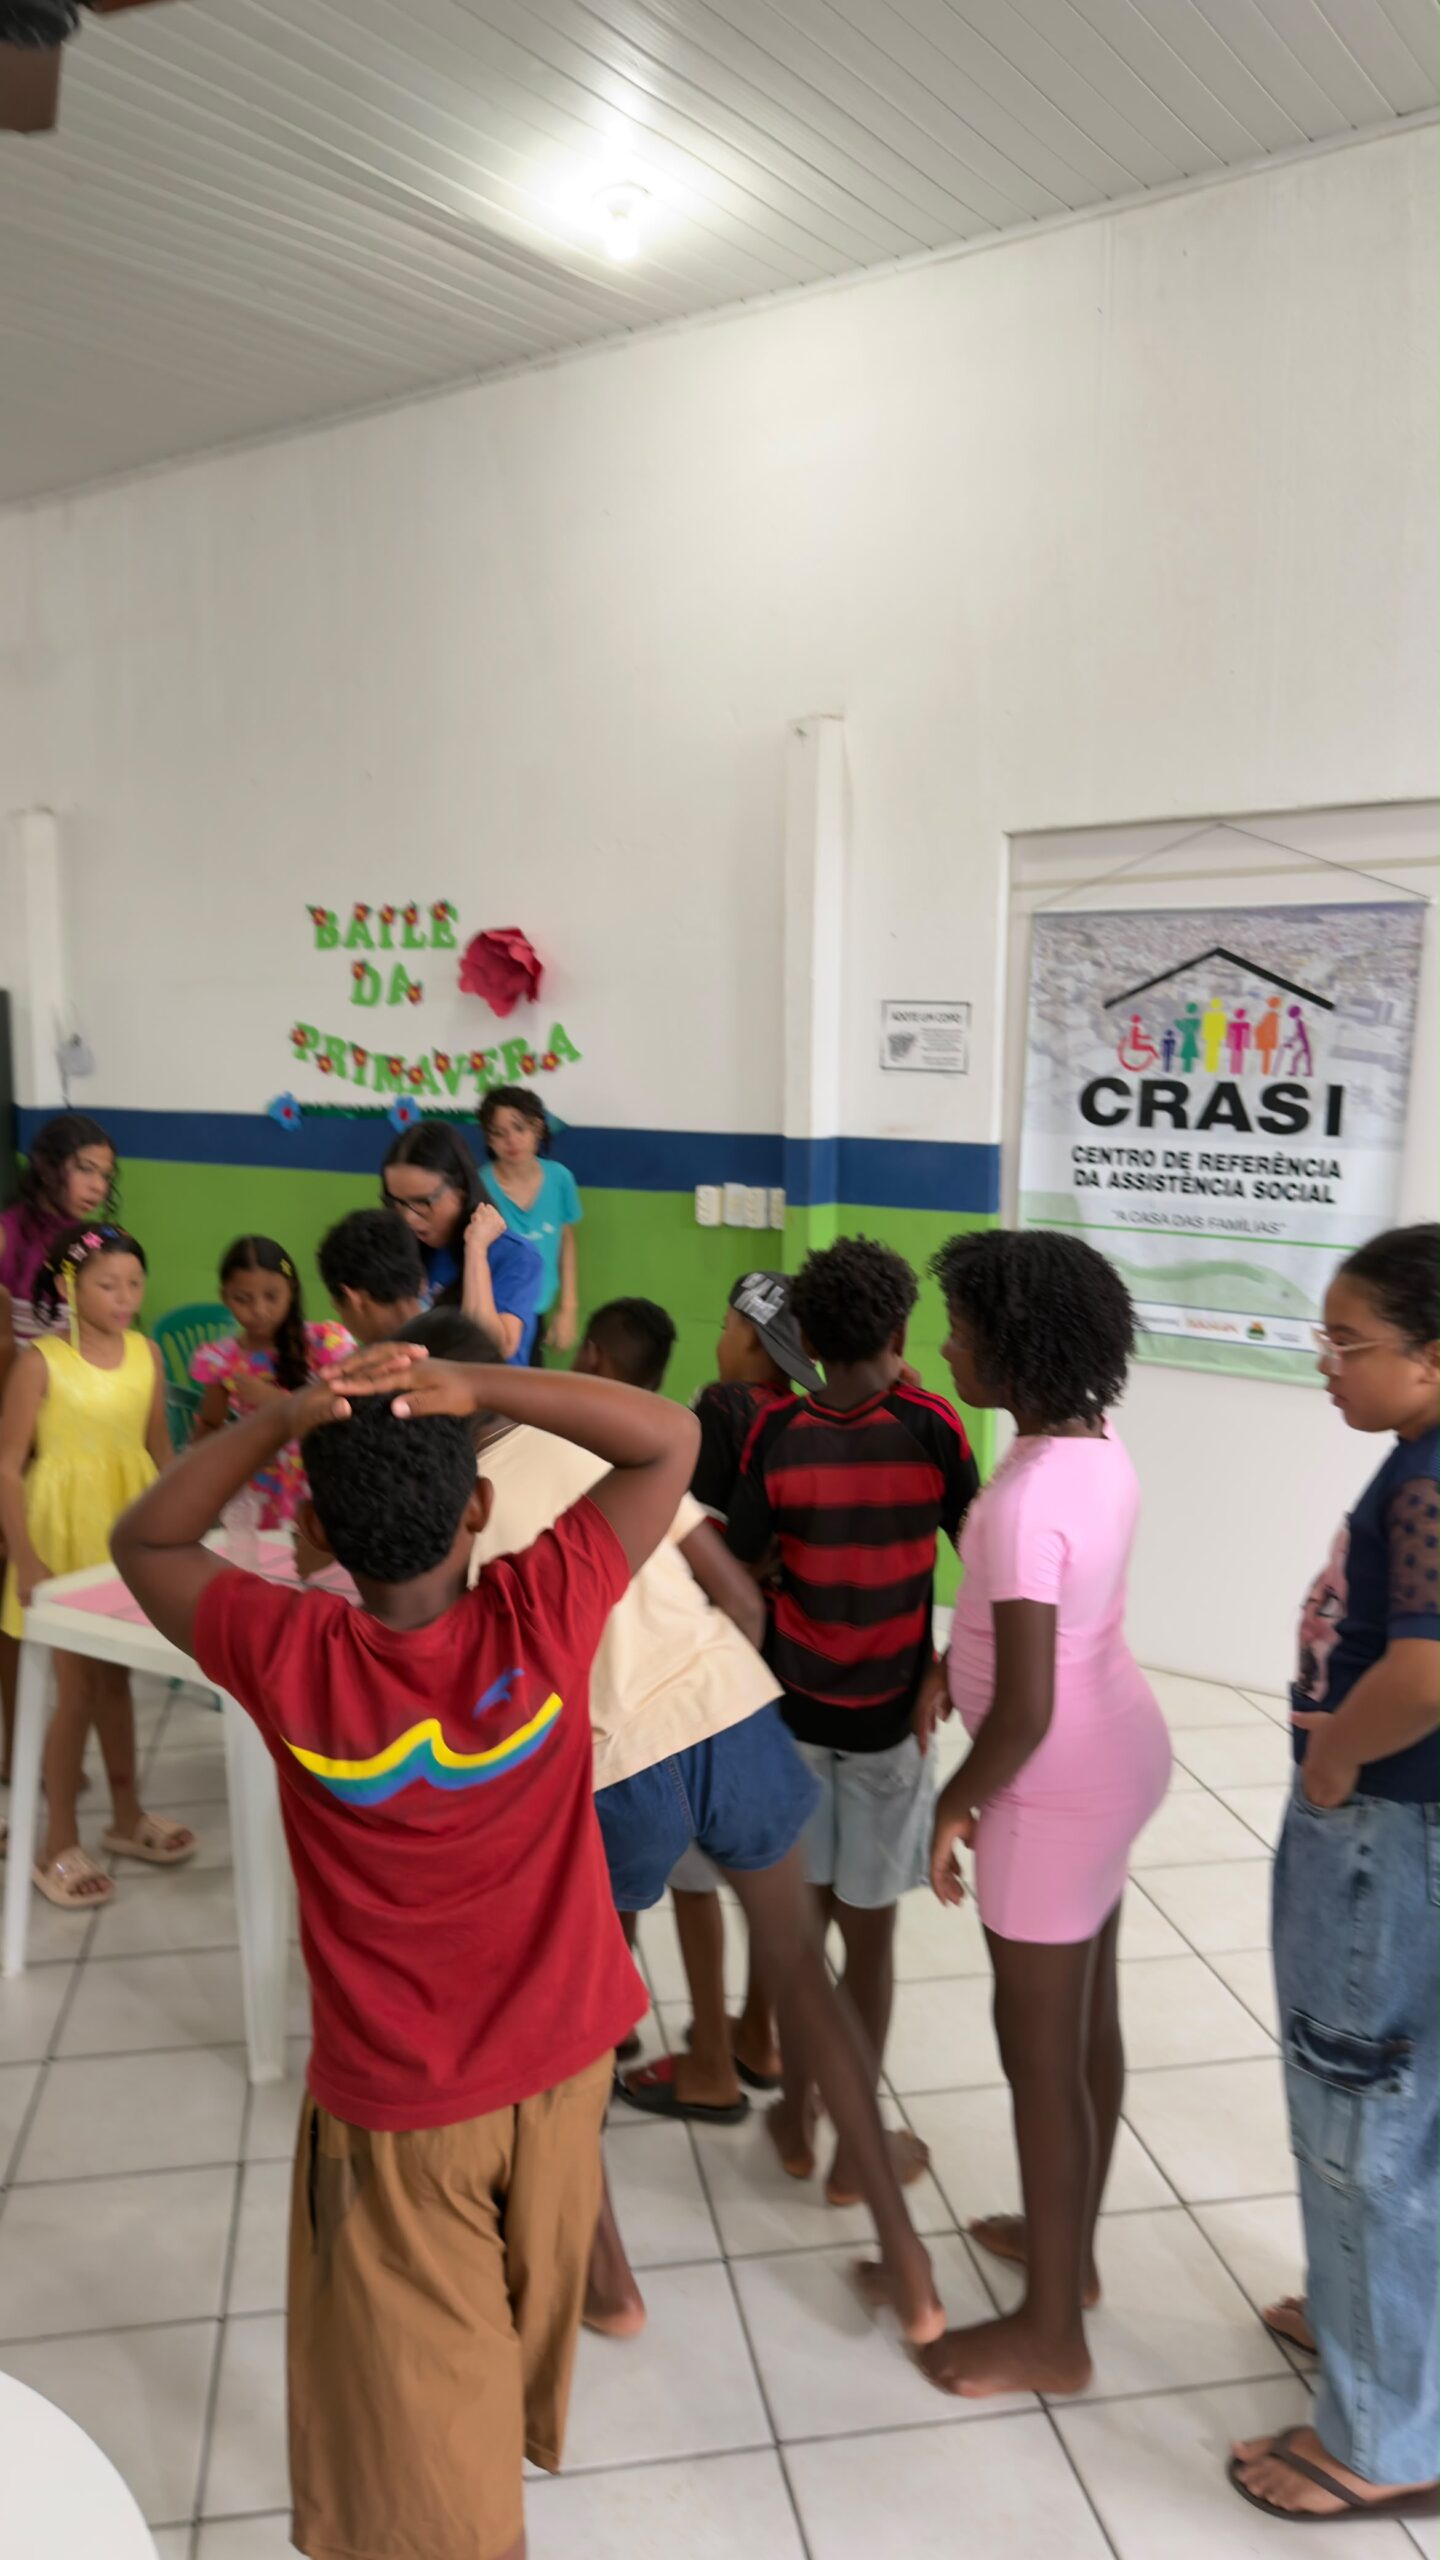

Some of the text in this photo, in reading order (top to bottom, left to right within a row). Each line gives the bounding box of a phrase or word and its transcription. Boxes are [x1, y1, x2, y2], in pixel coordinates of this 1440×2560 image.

[306, 901, 458, 950] BAILE
[351, 960, 422, 1006] DA
[1071, 1145, 1342, 1179] CENTRO DE REFERÊNCIA
[1073, 1168, 1337, 1204] DA ASSISTÊNCIA SOCIAL
[1130, 1210, 1170, 1226] CASA
[1172, 1213, 1204, 1229] DAS
